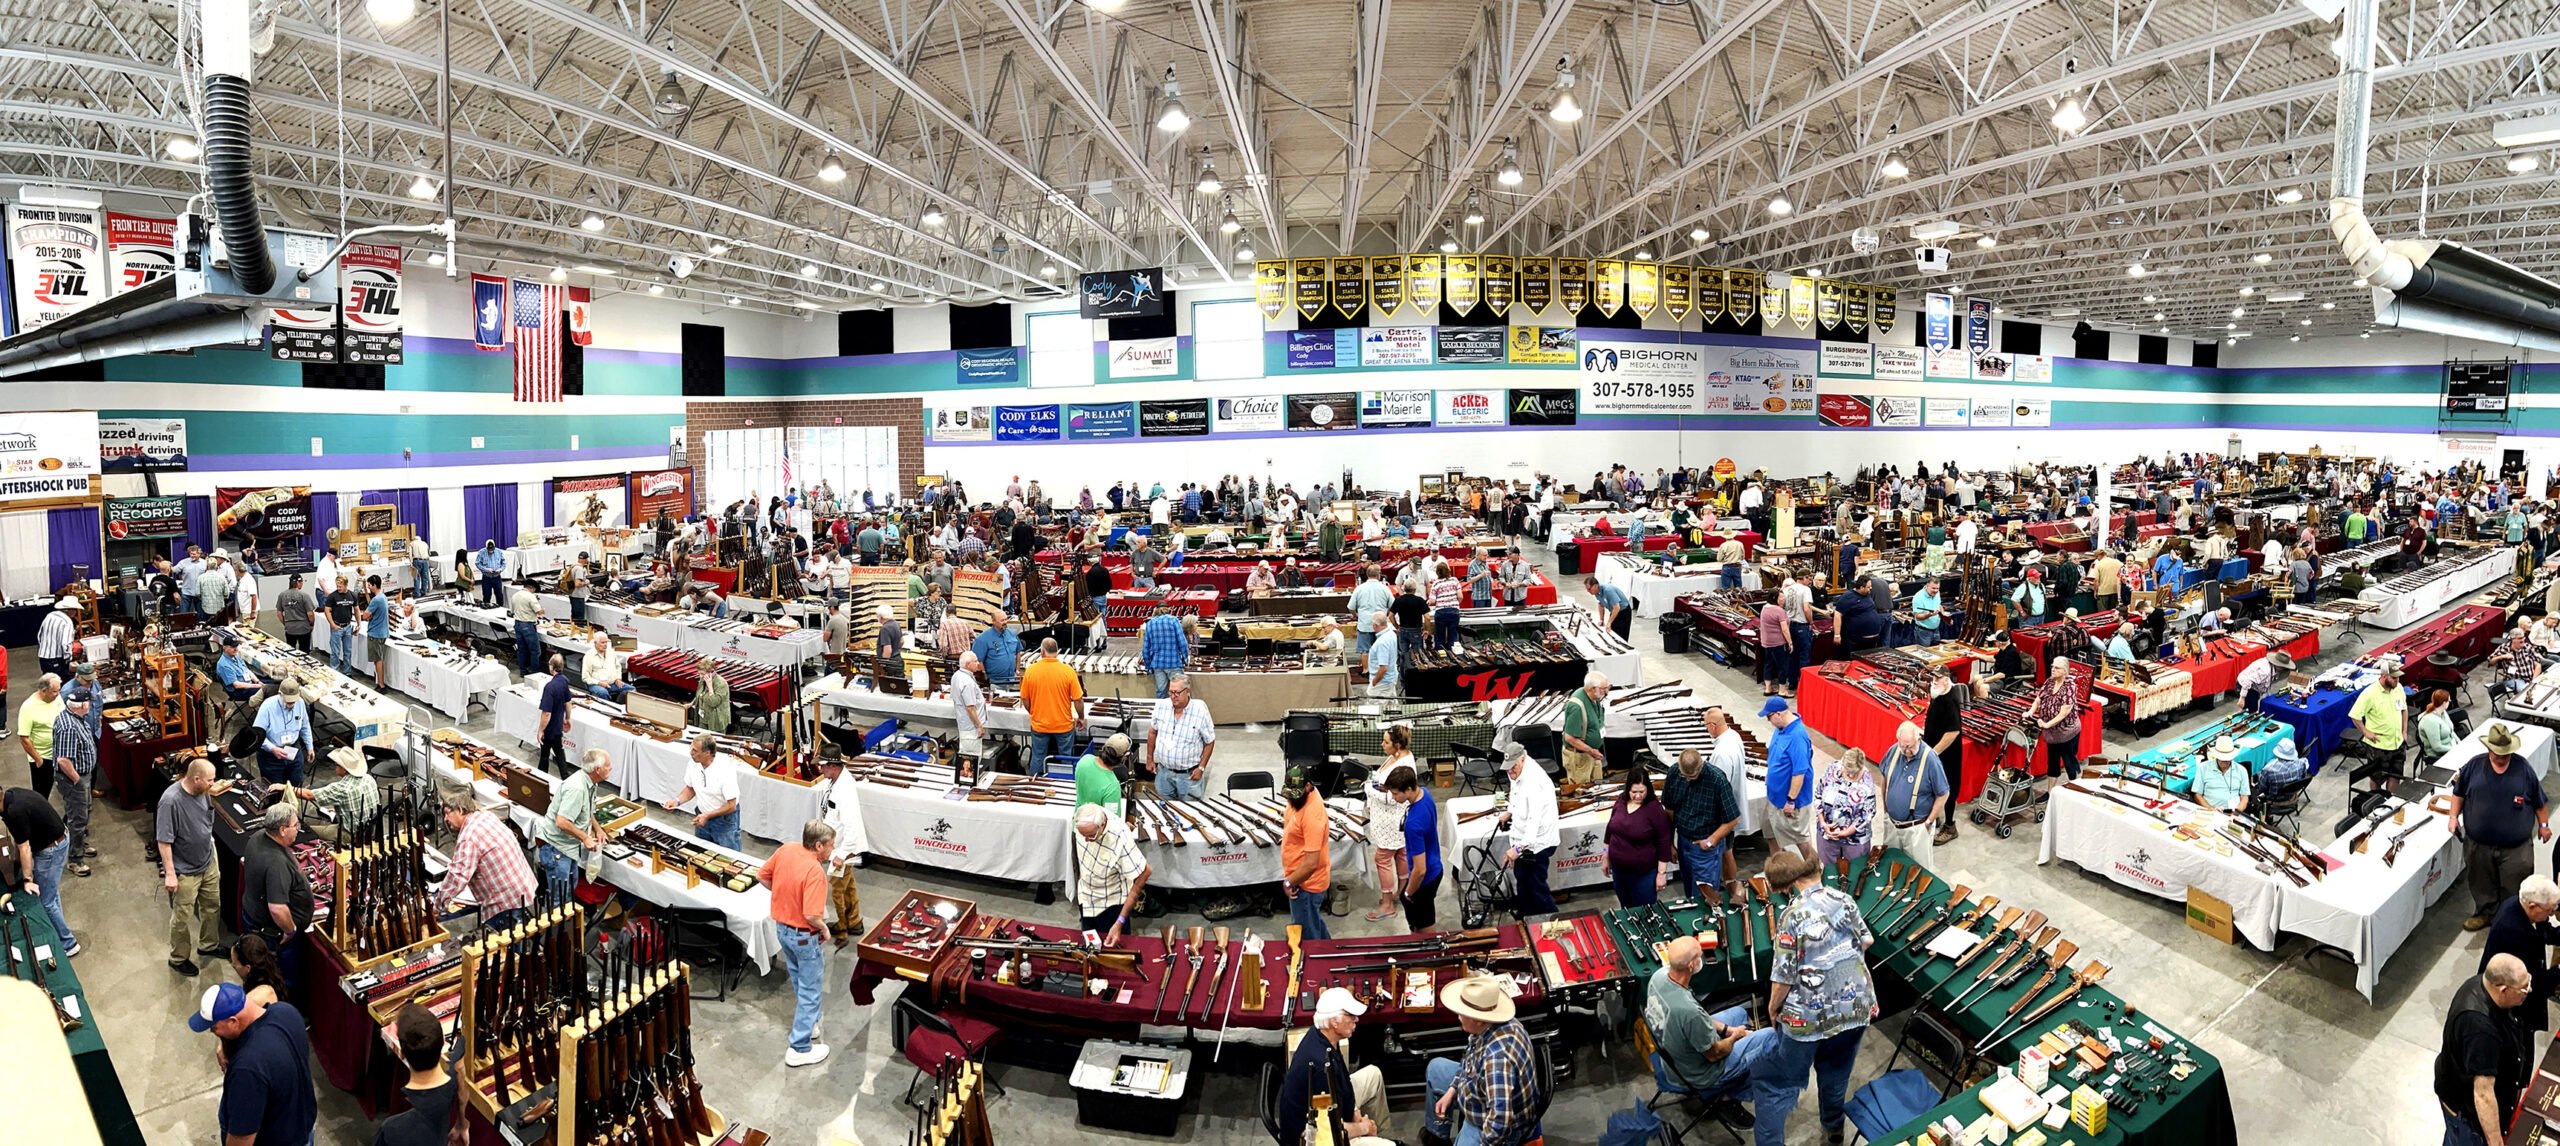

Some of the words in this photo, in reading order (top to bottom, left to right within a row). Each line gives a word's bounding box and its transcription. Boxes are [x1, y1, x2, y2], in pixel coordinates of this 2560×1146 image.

[18, 209, 56, 220] FRONTIER
[58, 211, 92, 224] DIVISION
[111, 219, 150, 233] FRONTIER
[21, 228, 93, 246] CHAMPIONS
[36, 247, 82, 259] 2015-2016
[374, 246, 400, 260] DIVISION
[34, 274, 88, 296] 3HL
[371, 281, 398, 289] AMERICAN
[1083, 275, 1116, 300] Cody
[345, 286, 400, 315] 3HL
[287, 331, 322, 340] YELLOWSTONE
[357, 335, 389, 343] YELLOWSTONE
[366, 342, 382, 350] QUAKE
[1290, 343, 1313, 353] Billings
[1314, 343, 1334, 351] Clinic
[1826, 346, 1867, 354] BURGSIMPSON
[1127, 349, 1173, 361] SUMMIT
[1620, 350, 1697, 361] BIGHORN
[1730, 358, 1740, 368] Big
[1776, 360, 1800, 369] Network
[1593, 382, 1694, 398] 307-578-1955
[1384, 391, 1430, 402] Morrison
[1453, 394, 1488, 407] ACKER
[1233, 398, 1278, 414] Choice
[1384, 404, 1422, 415] Maierle
[1545, 399, 1575, 410] McG's
[1595, 402, 1692, 410] www.bighornmedicalcenter.com
[1000, 412, 1026, 421] CODY
[1030, 411, 1056, 421] ELKS
[1084, 410, 1132, 419] RELIANT
[1143, 413, 1163, 421] PRINCIPLE
[1180, 411, 1206, 419] PETROLEUM
[99, 428, 136, 439] zzed
[138, 433, 174, 443] driving
[0, 438, 36, 449] etwork
[147, 446, 183, 455] driving
[67, 478, 87, 490] PUB
[561, 477, 620, 493] WINCHESTER
[642, 472, 683, 494] WINCHESTER
[110, 502, 135, 510] CODY
[136, 500, 182, 508] FIREARMS
[110, 507, 183, 520] RECORDS
[270, 515, 307, 524] FIREARMS
[272, 523, 305, 532] MUSEUM
[851, 567, 897, 575] WINCHESTER
[954, 573, 993, 582] WINCHESTER
[1457, 669, 1536, 701] W
[914, 838, 968, 852] WINCHESTER
[1200, 853, 1248, 863] WINCHESTER
[1556, 854, 1604, 868] WINCHEST
[2115, 862, 2166, 888] WINCHESTER
